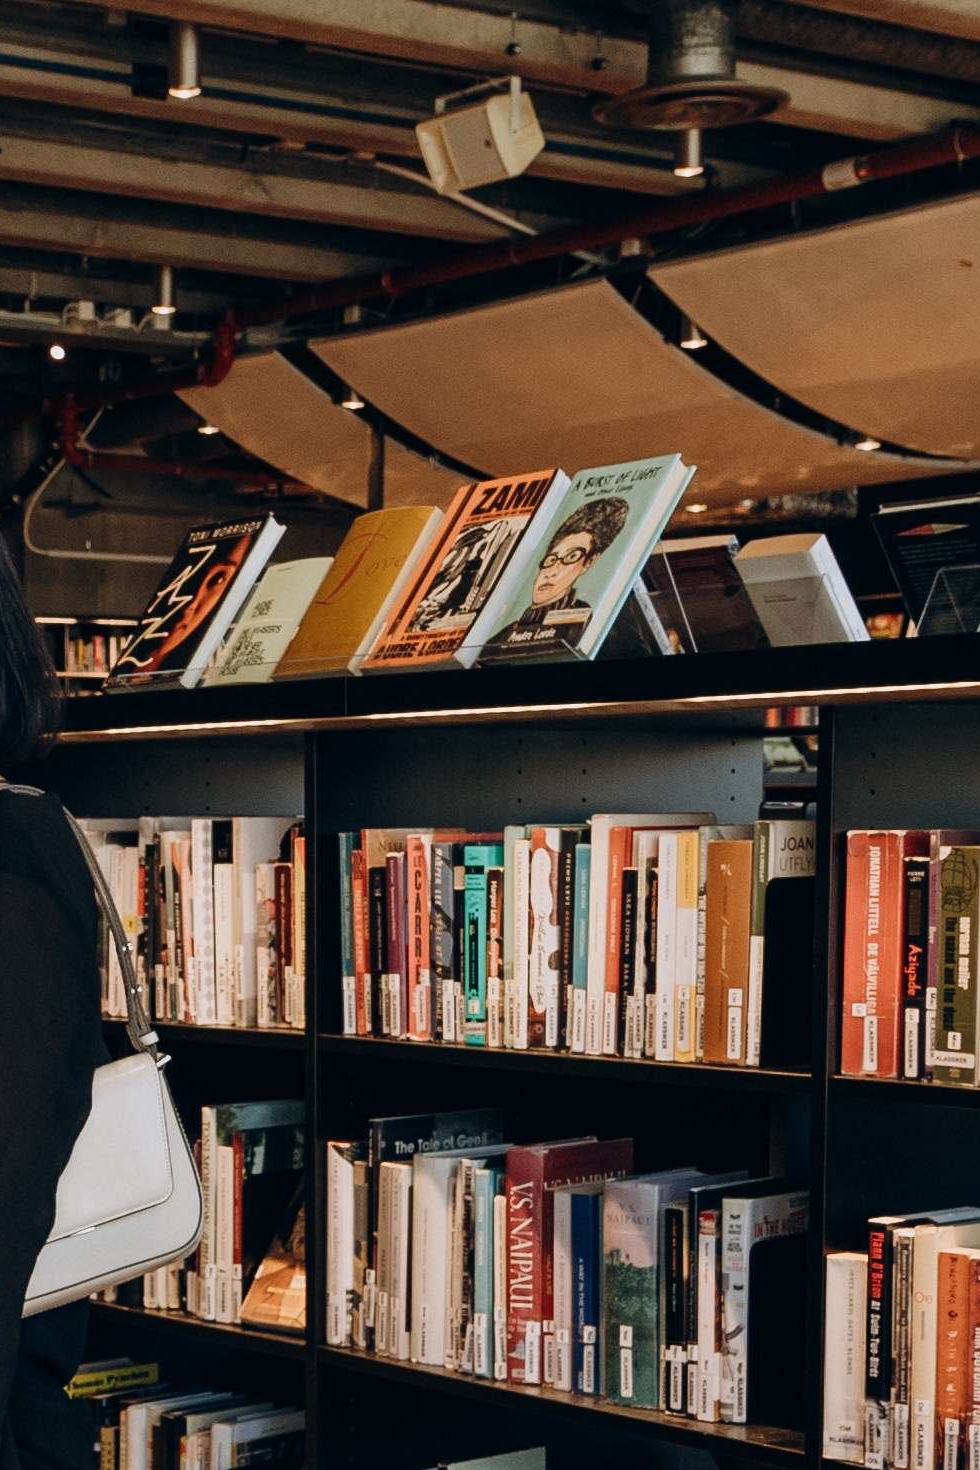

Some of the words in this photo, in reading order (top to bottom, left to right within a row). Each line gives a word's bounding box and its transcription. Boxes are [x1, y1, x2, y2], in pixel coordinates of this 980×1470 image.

[572, 480, 581, 493] A
[584, 474, 615, 490] BURST
[615, 471, 628, 486] OF
[631, 466, 662, 483] LIGHT
[471, 478, 550, 515] ZAMI
[188, 531, 208, 542] TONI
[212, 521, 262, 537] MORRISON
[508, 629, 532, 642] Audre
[534, 626, 556, 639] Lorde
[780, 836, 814, 853] JOAN
[435, 848, 443, 884] HARPER
[869, 846, 881, 897] JONATHAN
[489, 881, 498, 907] Harper
[867, 898, 879, 936] LITTELL
[945, 917, 958, 932] the
[867, 943, 878, 956] DE
[945, 936, 957, 963] naked
[958, 917, 971, 955] norman
[904, 944, 923, 997] Aziyade
[945, 968, 956, 984] and
[957, 957, 970, 991] mailer
[865, 958, 879, 1014] VÄLVILLIGA
[944, 988, 956, 1003] the
[943, 1007, 956, 1030] dead
[202, 1121, 210, 1152] TONI
[394, 1140, 415, 1154] The
[417, 1137, 440, 1151] Tale
[202, 1155, 210, 1224] MORRISON
[510, 1181, 534, 1213] V.S.
[872, 1232, 884, 1259] Flann
[510, 1217, 534, 1314] NAIPAUL
[578, 1283, 584, 1292] IN
[872, 1262, 883, 1298] O'Brien
